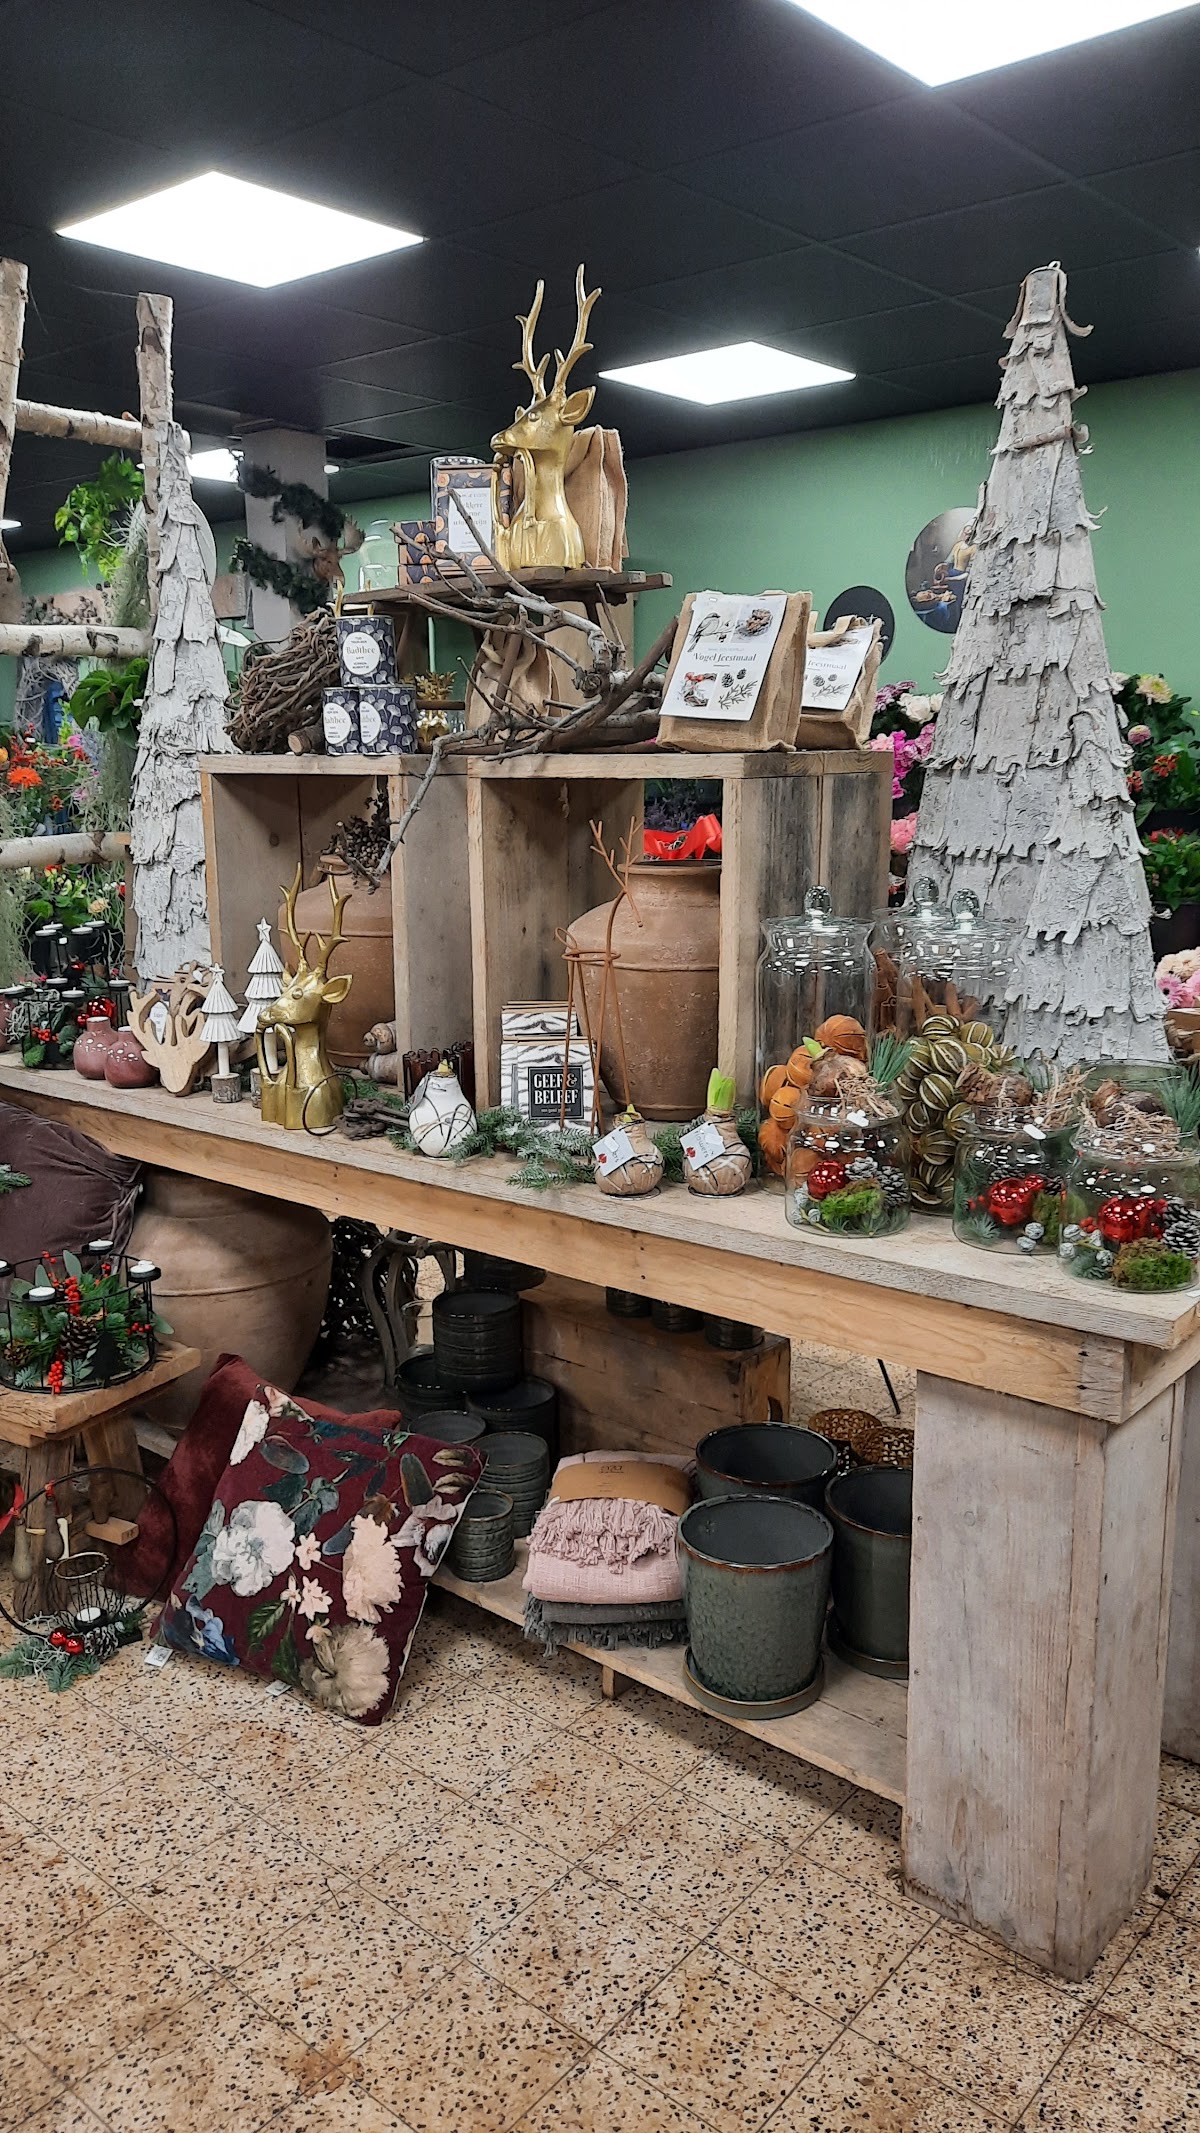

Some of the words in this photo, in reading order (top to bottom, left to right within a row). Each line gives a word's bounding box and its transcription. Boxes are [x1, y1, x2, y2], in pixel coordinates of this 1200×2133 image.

[693, 653, 717, 662] Vogel
[715, 653, 757, 663] feestmaal
[533, 1073, 564, 1089] GEEF
[566, 1073, 578, 1088] &
[534, 1089, 579, 1105] BELEEF
